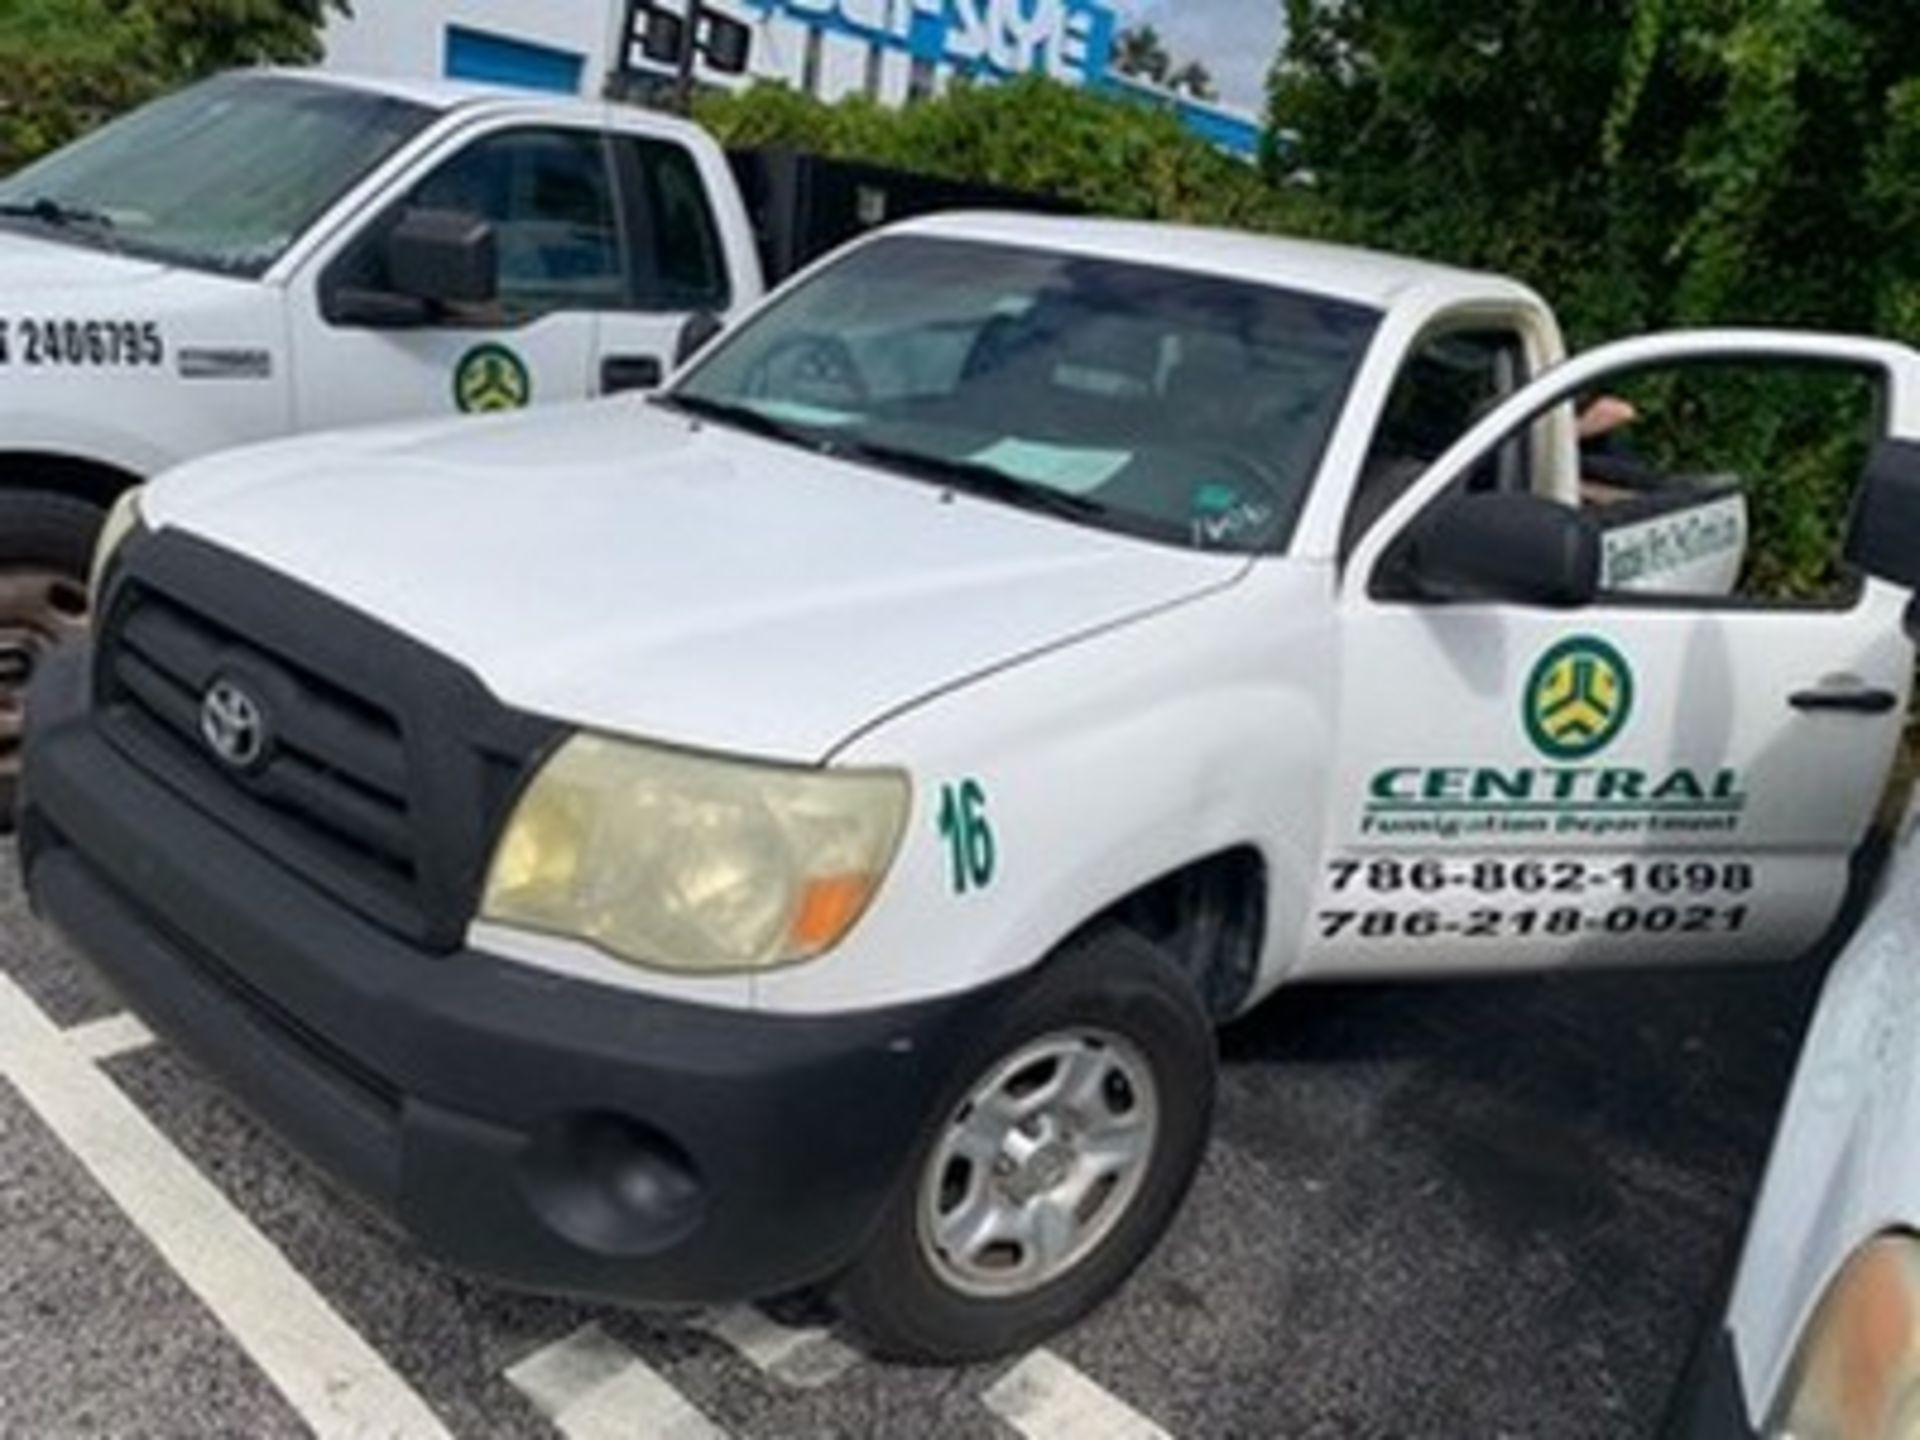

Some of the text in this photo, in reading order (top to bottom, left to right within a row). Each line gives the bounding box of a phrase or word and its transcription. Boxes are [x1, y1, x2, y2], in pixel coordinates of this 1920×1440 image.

[1370, 767, 1746, 799] CENTRAL
[938, 778, 995, 894] 16
[1361, 814, 1738, 838] Fumigation Department
[1328, 860, 1754, 894] 786-862-1698
[1318, 905, 1748, 938] 786-218-0021
